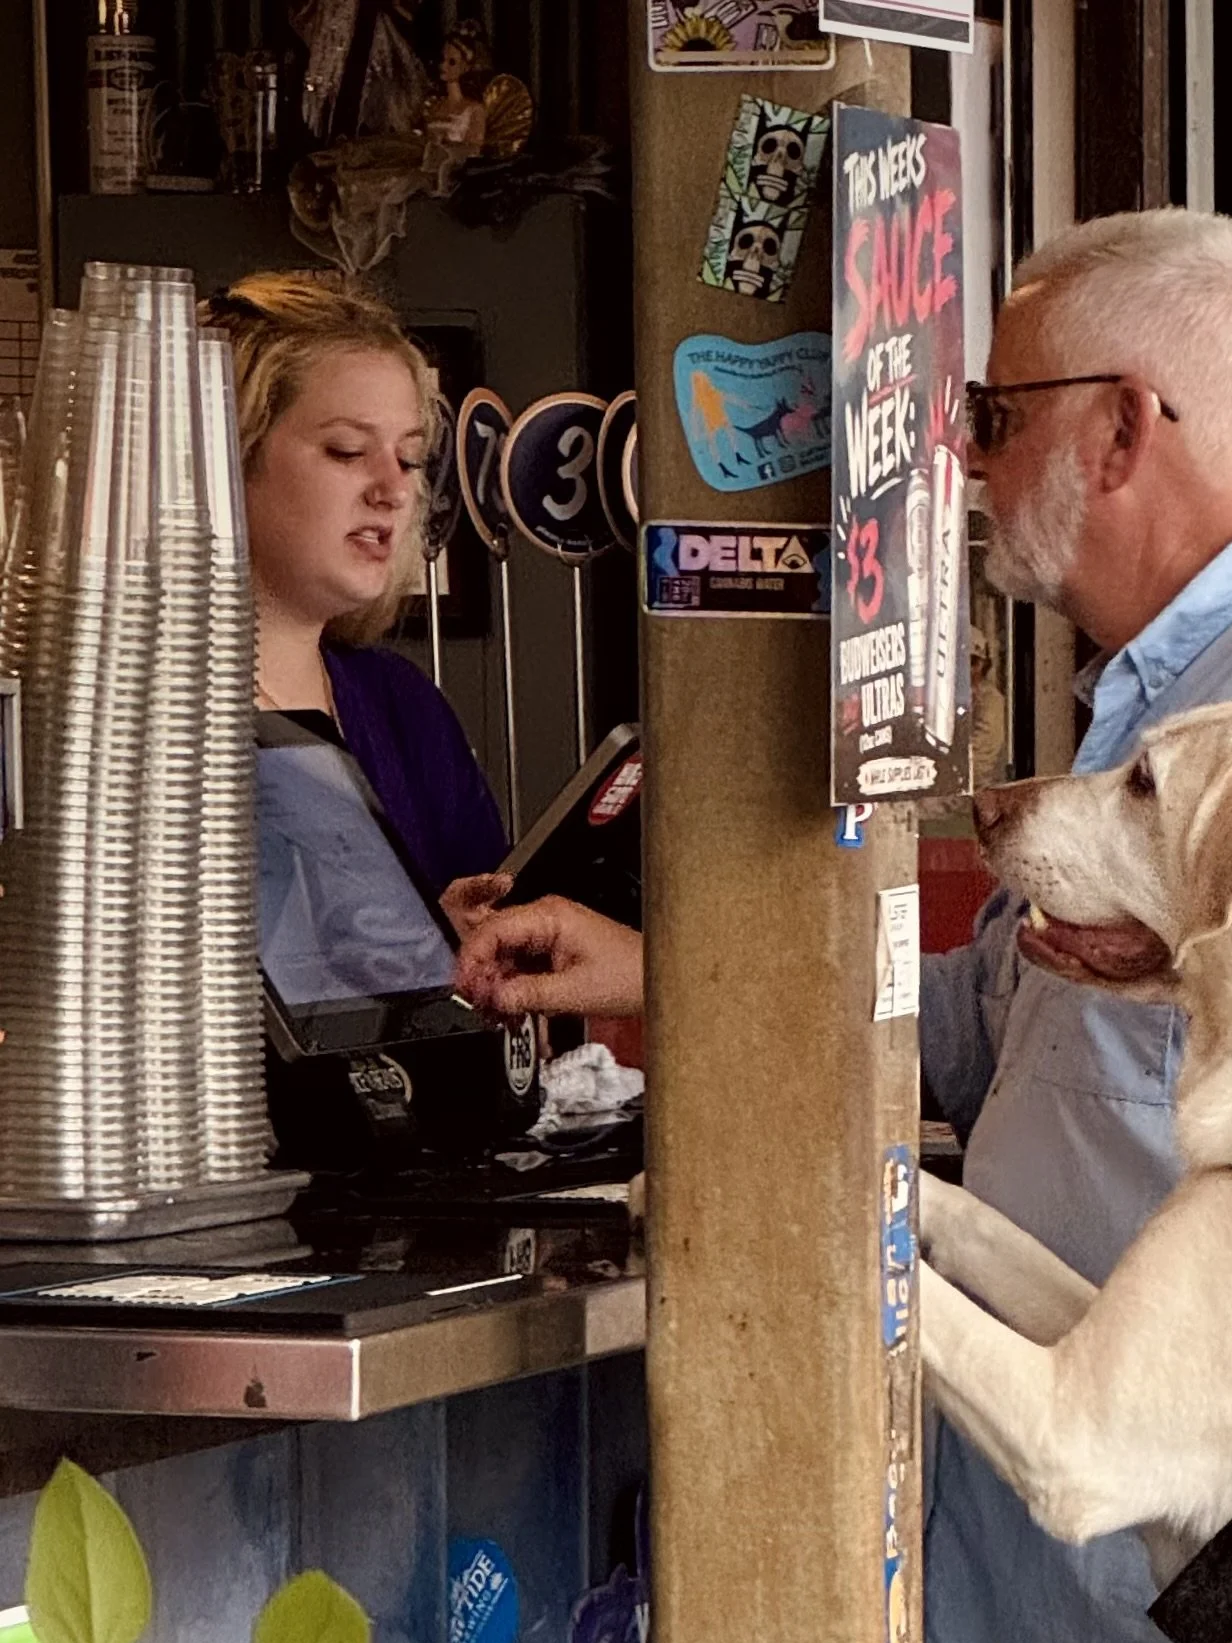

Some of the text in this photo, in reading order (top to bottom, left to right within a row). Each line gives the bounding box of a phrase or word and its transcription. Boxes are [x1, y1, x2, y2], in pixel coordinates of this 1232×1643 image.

[843, 132, 927, 216] THIS WEEKS
[843, 187, 958, 364] SAUCE
[687, 350, 716, 364] THE
[866, 333, 914, 391] OF THE
[541, 425, 594, 521] 3
[845, 386, 916, 499] WEEK:
[678, 534, 815, 573] DELTA
[839, 621, 906, 685] BUDWEISERS
[860, 672, 905, 728] ULTRAS
